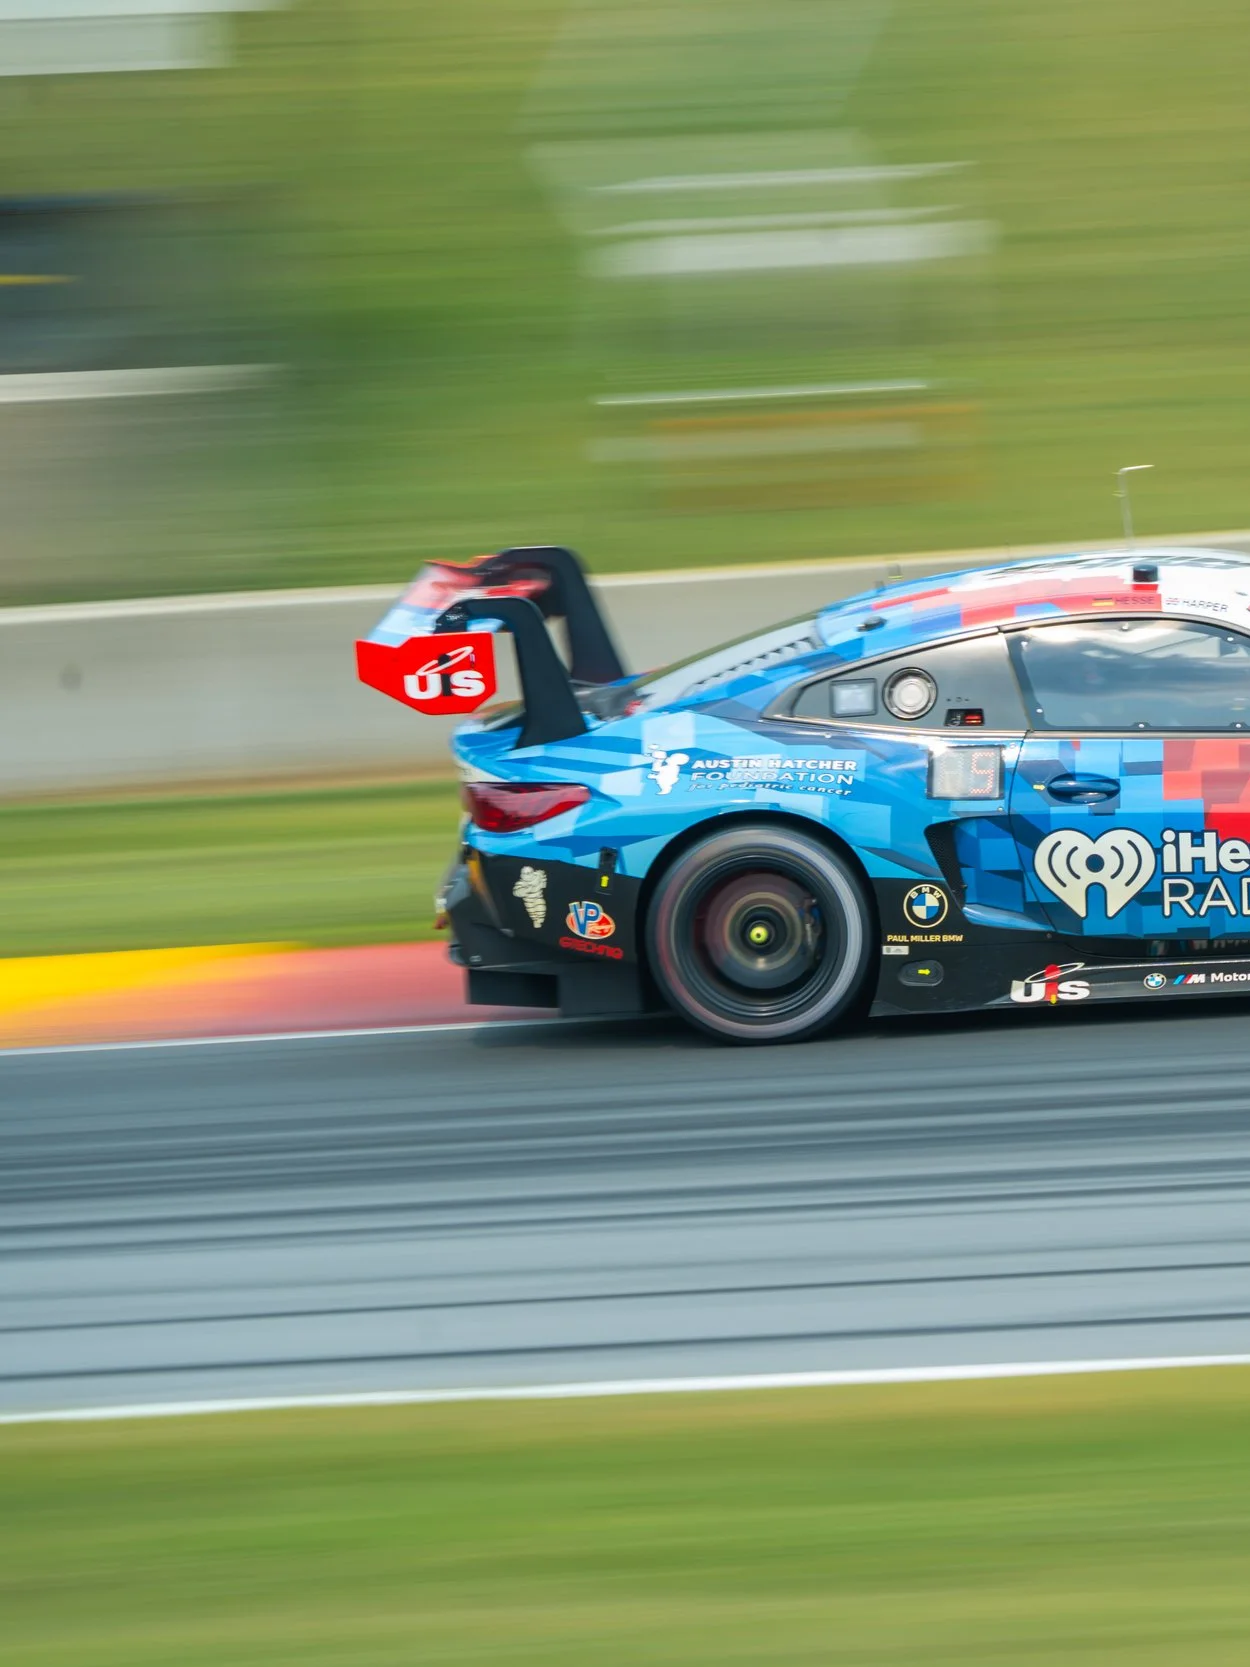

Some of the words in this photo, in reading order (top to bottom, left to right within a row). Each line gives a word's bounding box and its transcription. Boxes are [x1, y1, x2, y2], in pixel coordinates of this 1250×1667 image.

[1183, 600, 1228, 612] HARPER
[691, 759, 762, 769] AUSTIN
[769, 760, 857, 771] HATCHER
[691, 771, 854, 785] FOUNDATION
[718, 782, 792, 790] pediatric
[800, 785, 852, 796] cancer
[569, 901, 604, 936] VP
[1010, 979, 1090, 1003] UIS
